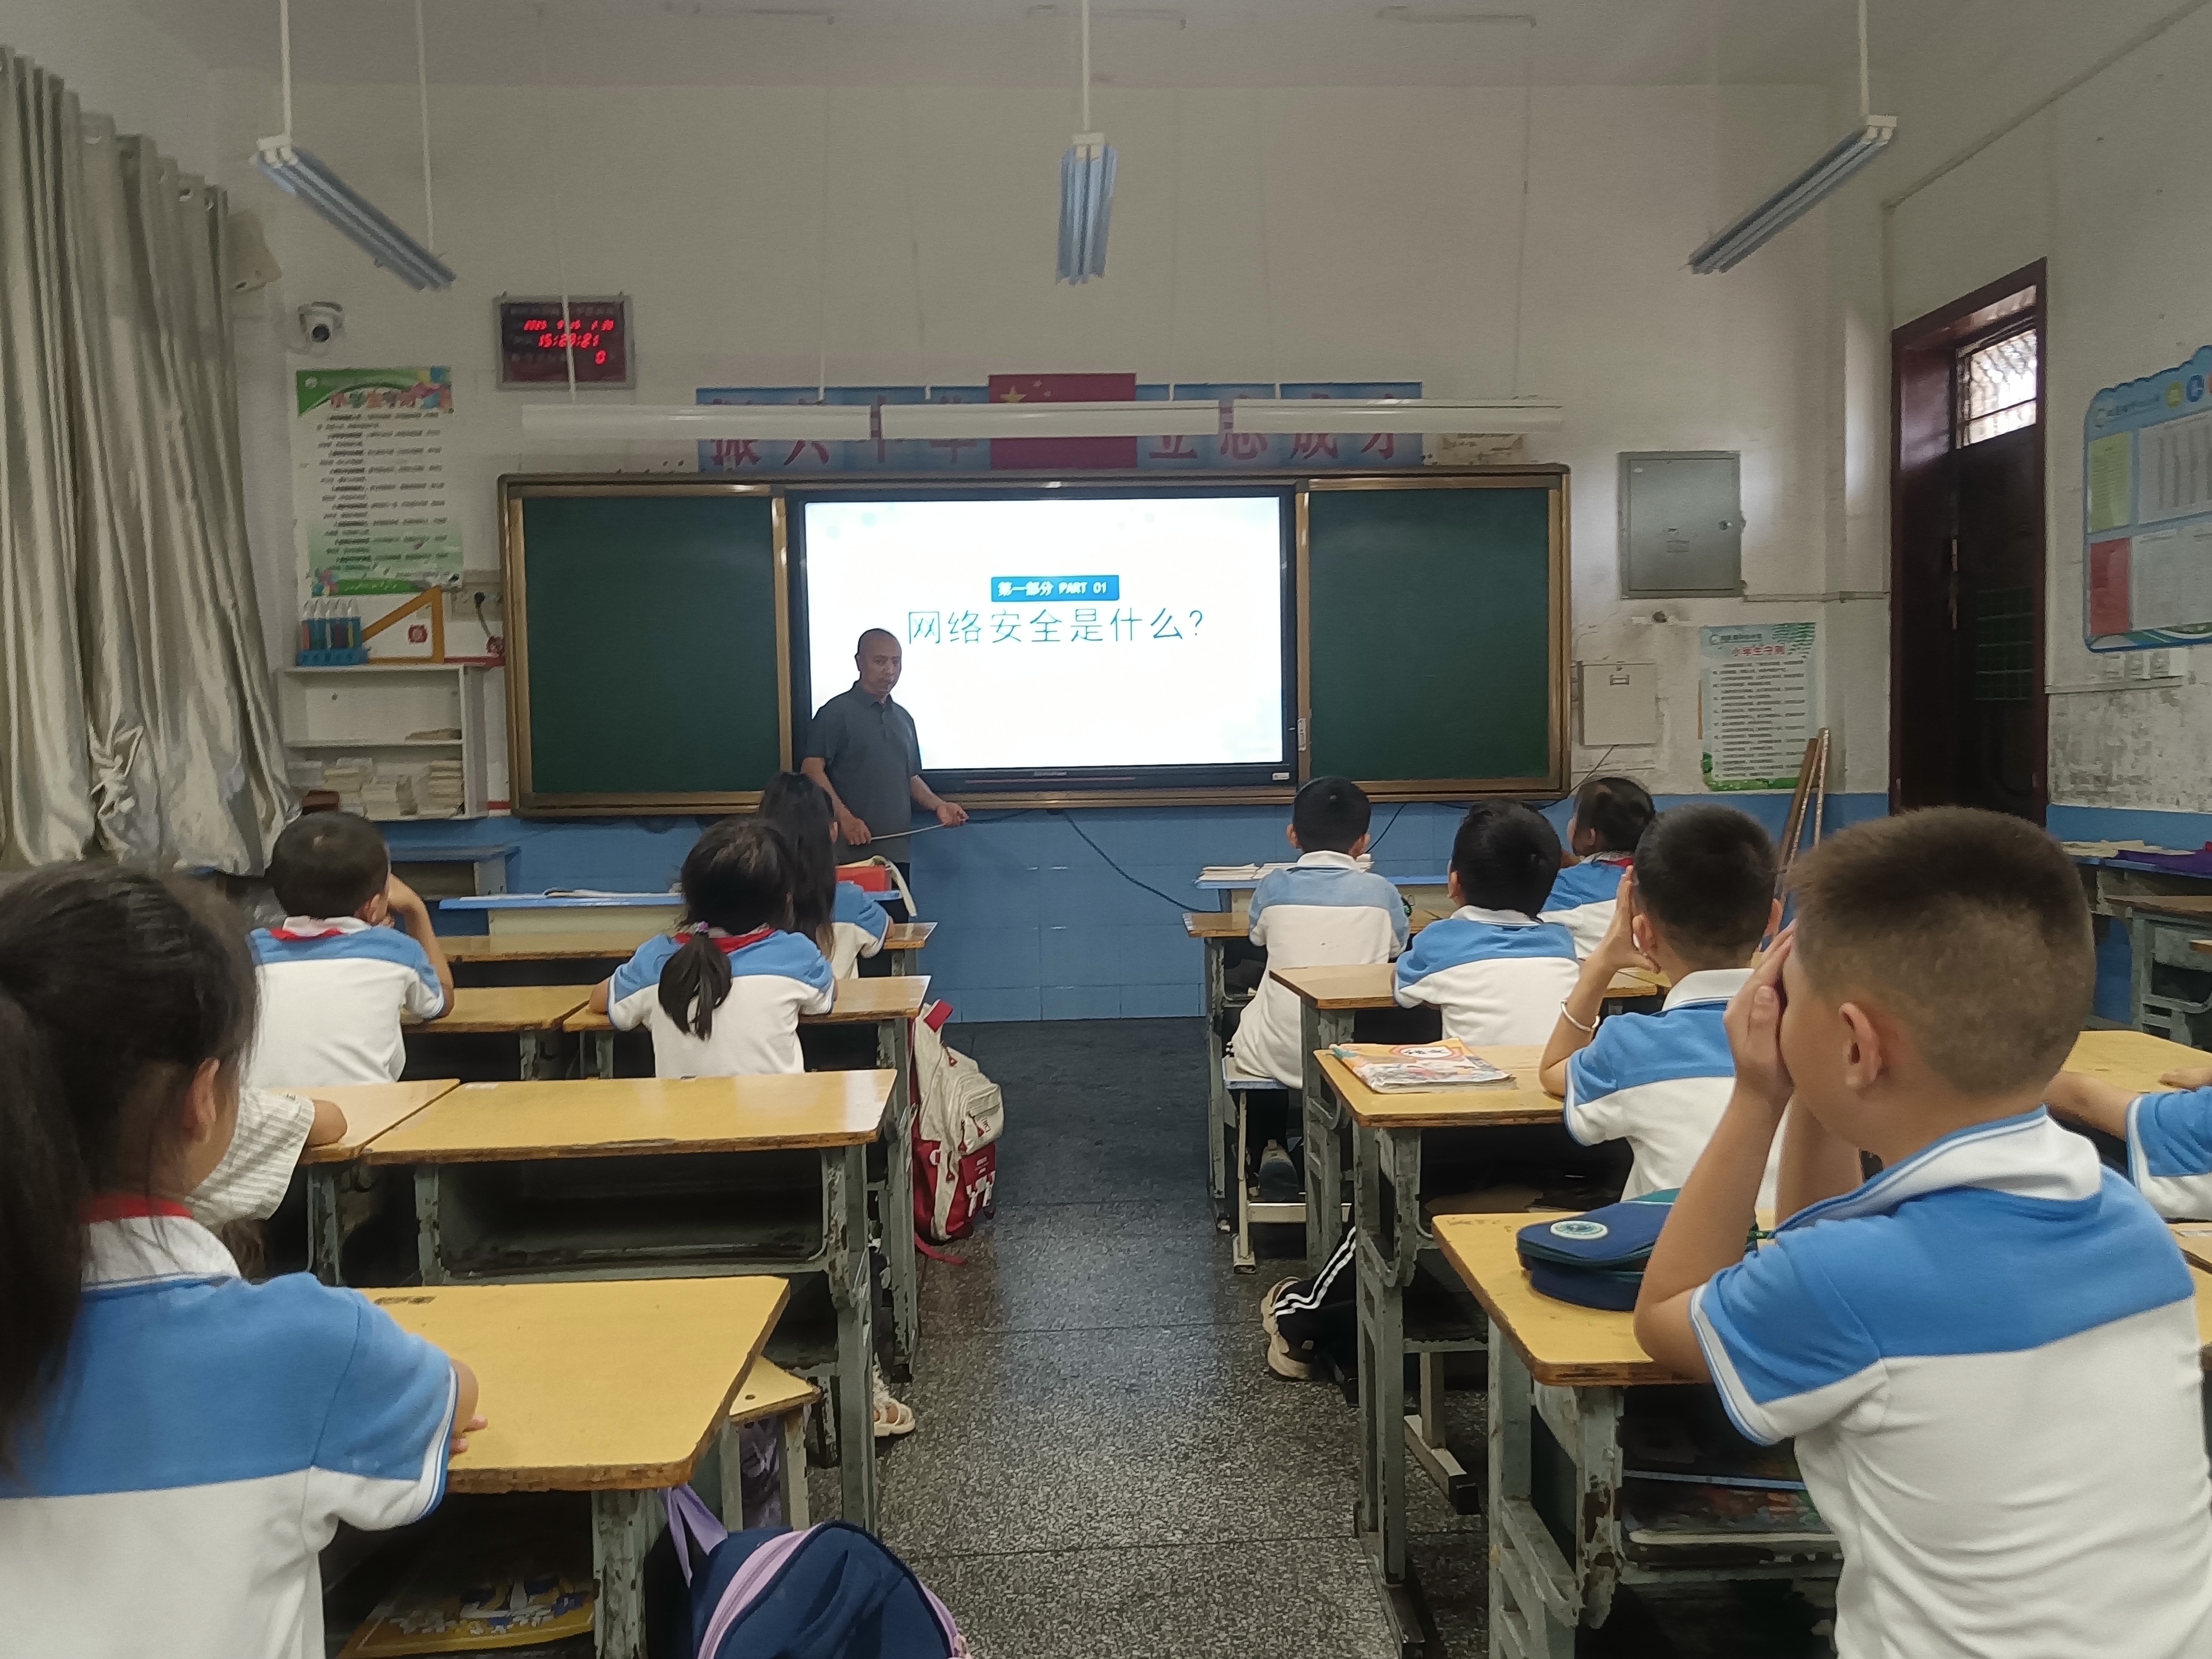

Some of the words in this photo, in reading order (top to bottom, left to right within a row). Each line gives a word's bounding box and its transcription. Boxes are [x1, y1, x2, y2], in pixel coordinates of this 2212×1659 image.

[1058, 581, 1088, 594] PART
[1093, 581, 1106, 594] 01
[908, 607, 1202, 644] 网络安全是什么?
